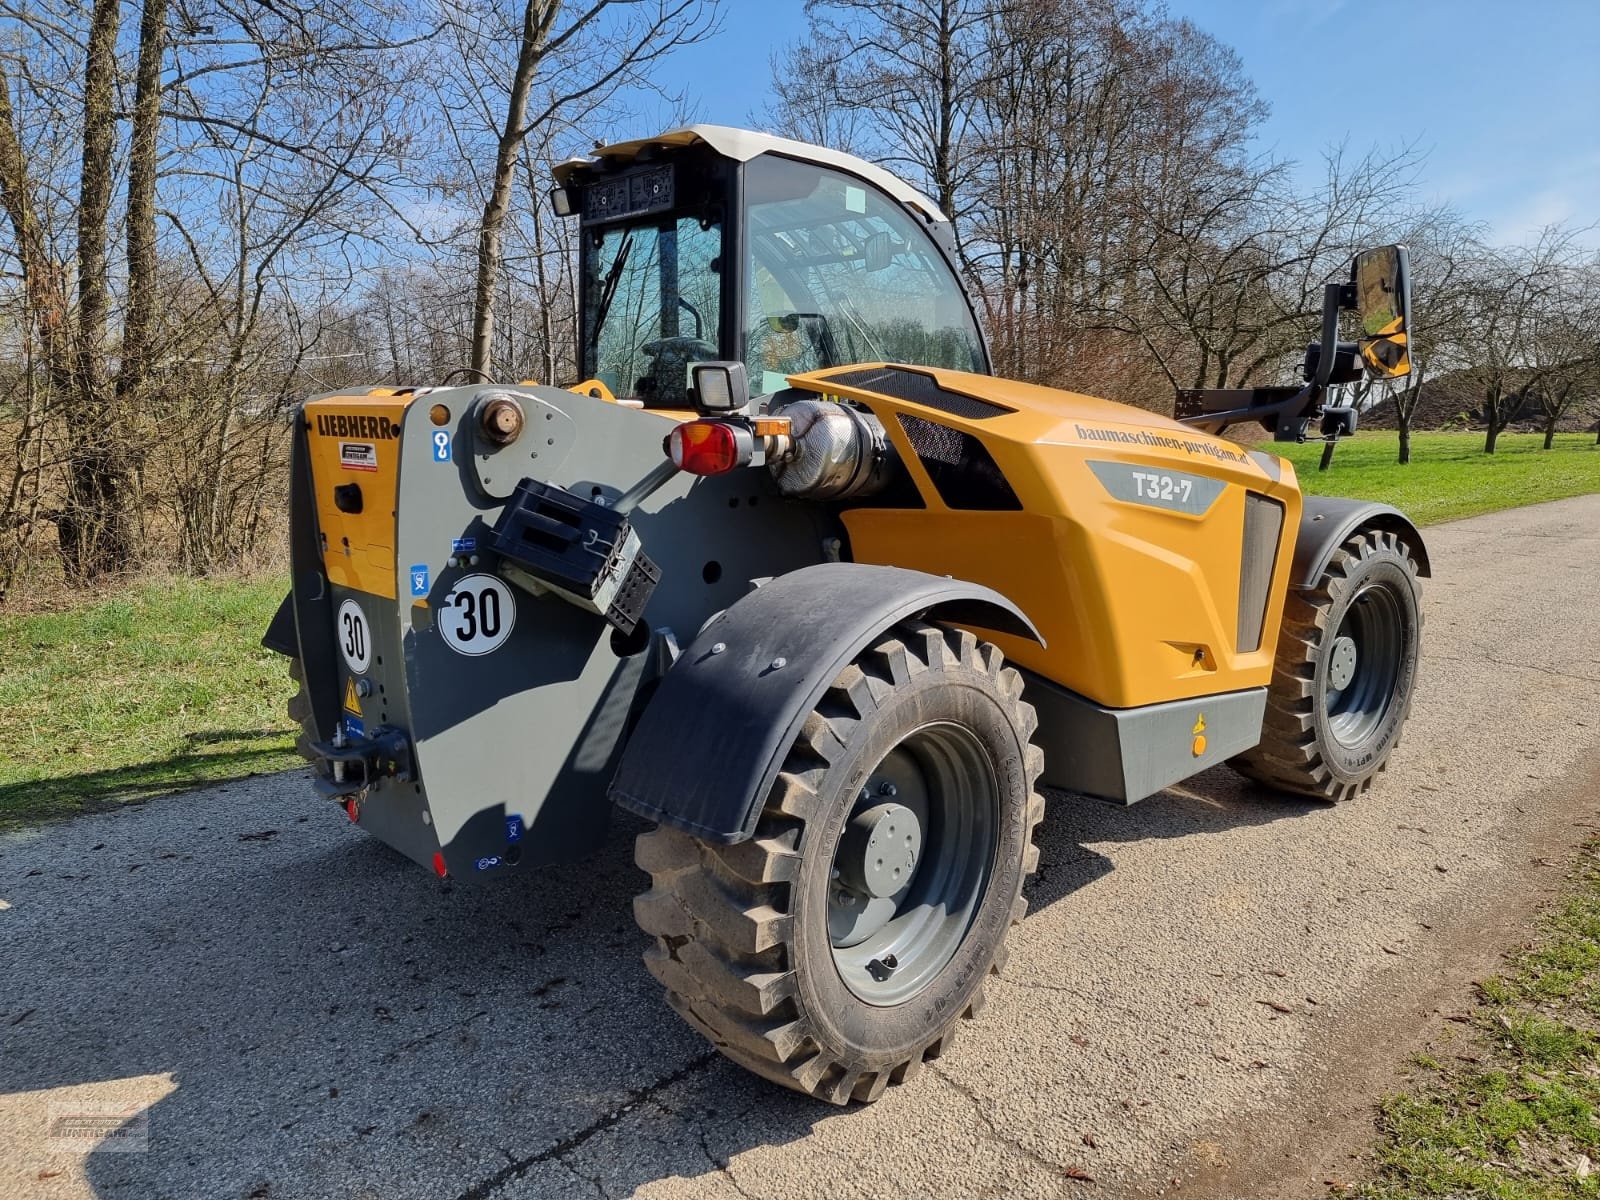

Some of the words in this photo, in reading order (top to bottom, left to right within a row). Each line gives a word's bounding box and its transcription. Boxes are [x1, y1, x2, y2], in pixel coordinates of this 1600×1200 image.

[317, 414, 393, 440] LIEBHERR
[1075, 424, 1250, 466] baumaschinen-puntigam.at
[1132, 472, 1193, 503] T32-7
[454, 587, 501, 642] 30
[343, 612, 365, 661] 30
